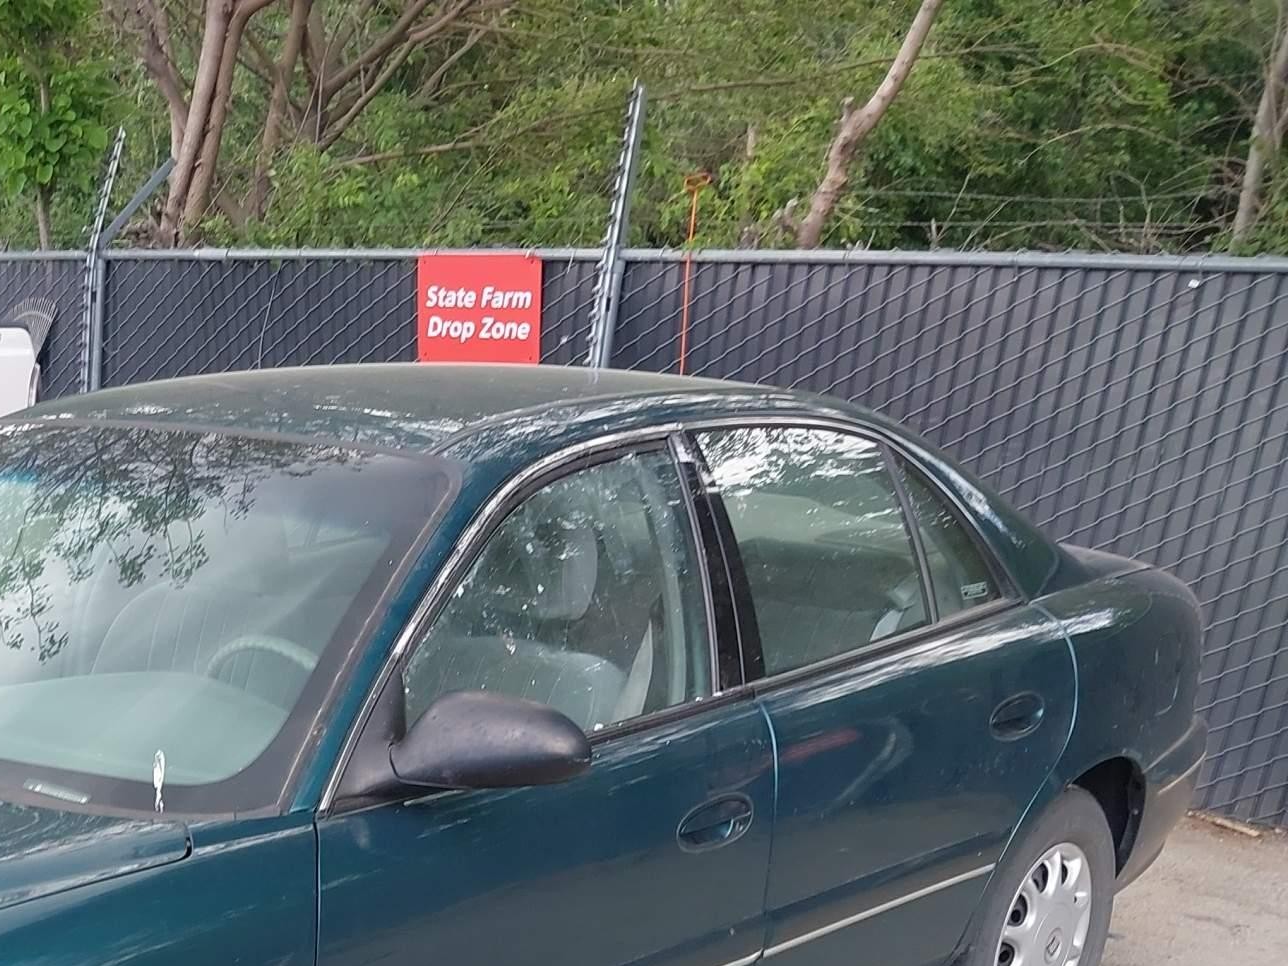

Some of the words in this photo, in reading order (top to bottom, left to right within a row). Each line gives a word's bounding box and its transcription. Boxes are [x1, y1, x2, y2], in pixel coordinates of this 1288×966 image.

[425, 285, 477, 308] State
[480, 286, 532, 309] Farm
[427, 315, 475, 343] Drop
[478, 316, 531, 340] Zone
